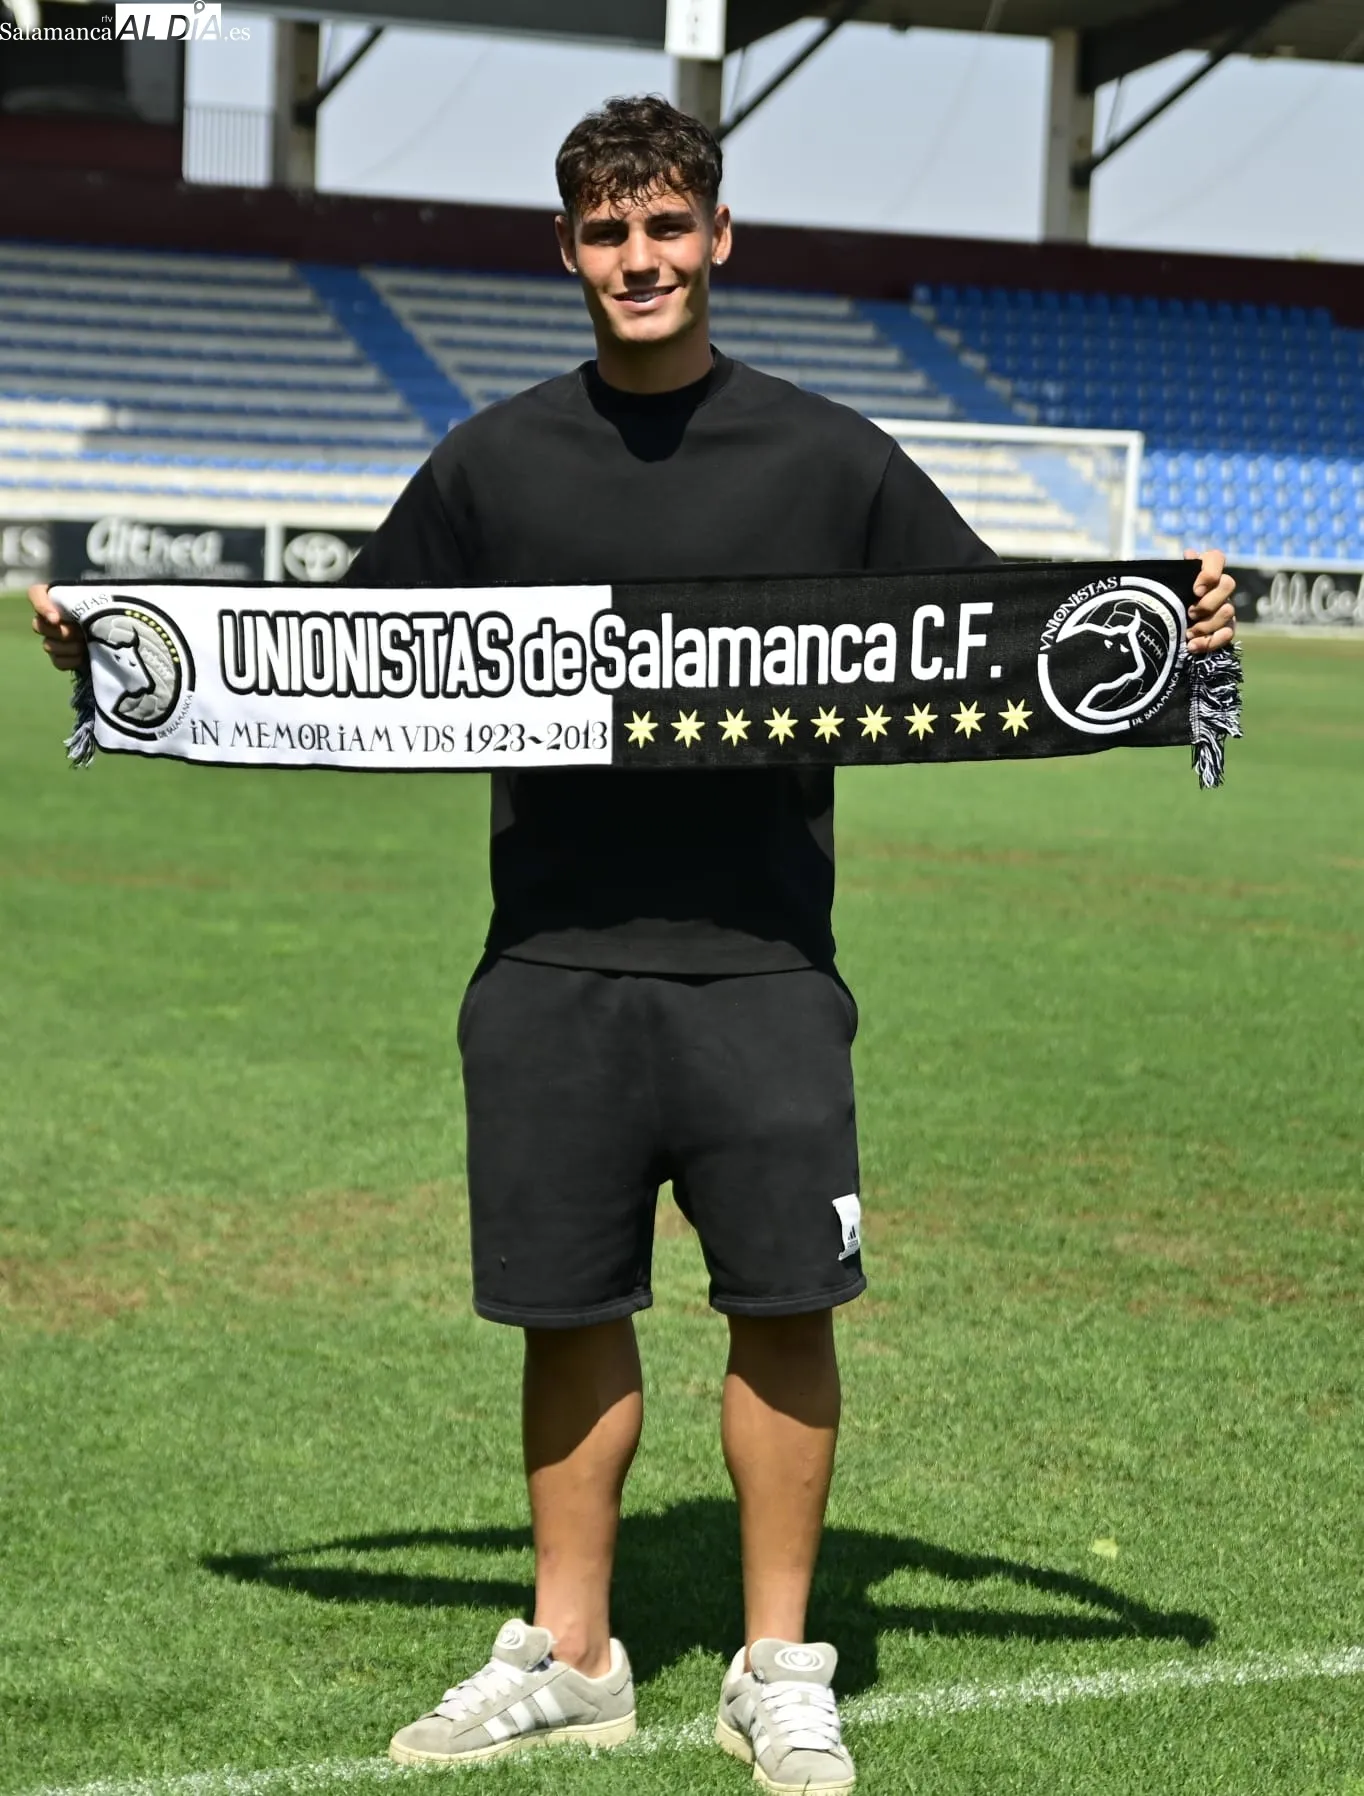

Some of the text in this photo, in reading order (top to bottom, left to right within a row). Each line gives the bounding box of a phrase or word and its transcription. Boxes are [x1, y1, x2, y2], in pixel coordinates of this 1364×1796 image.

[218, 602, 1001, 698] UNIONISTAS de Salamanca C.F.
[399, 724, 455, 753] VDS
